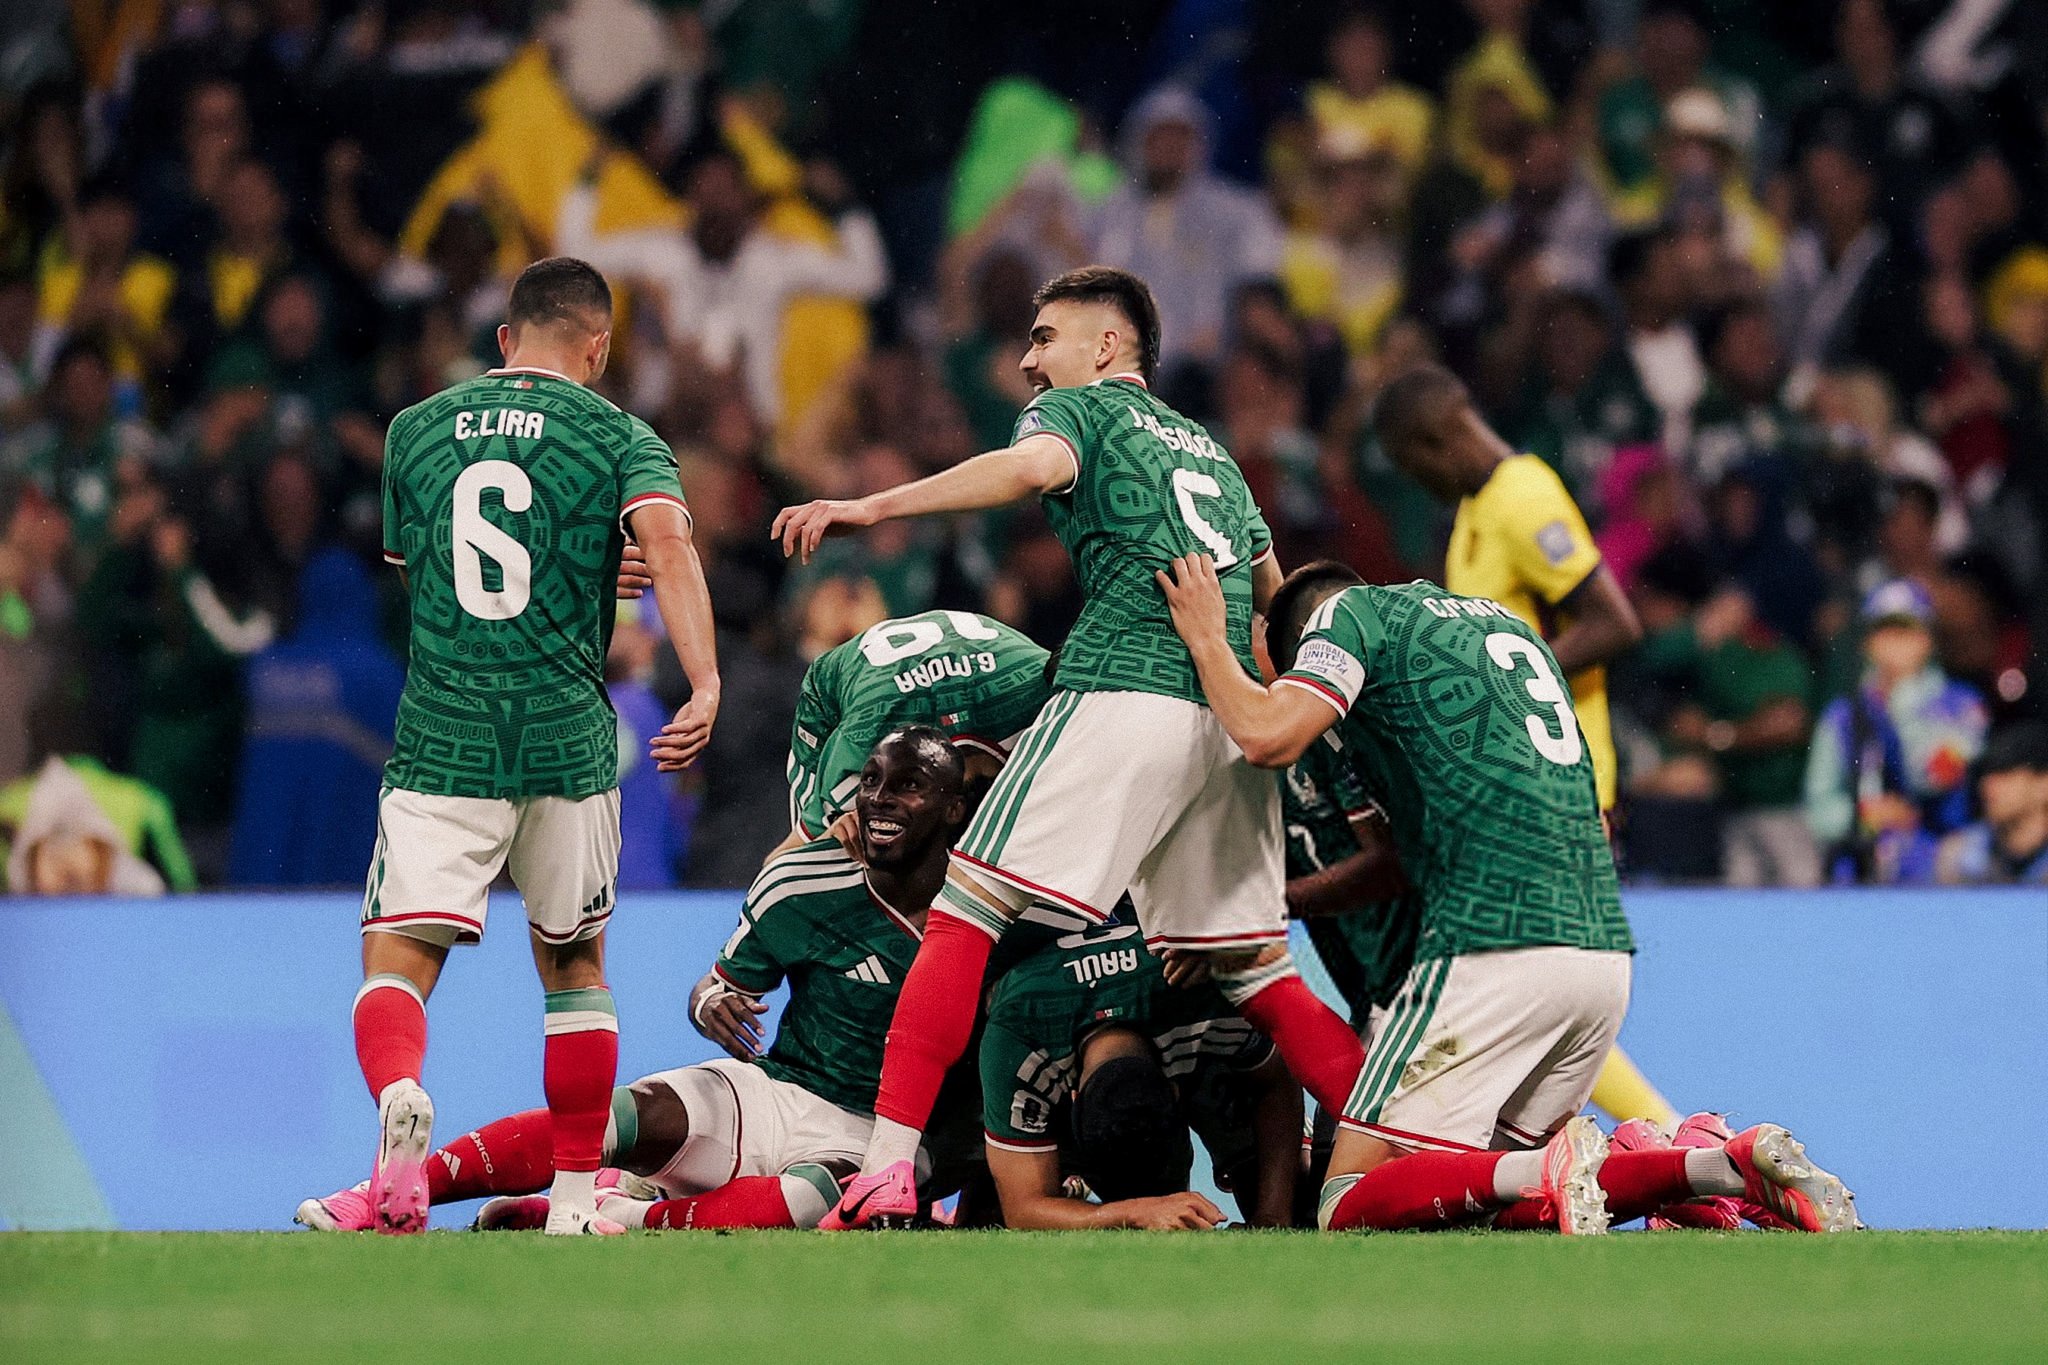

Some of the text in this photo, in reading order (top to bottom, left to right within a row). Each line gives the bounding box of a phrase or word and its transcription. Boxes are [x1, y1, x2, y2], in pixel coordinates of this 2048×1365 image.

[454, 409, 545, 440] E.LIRA
[452, 460, 532, 620] 6
[1173, 468, 1238, 570] 5
[893, 651, 996, 693] G.MORA
[1485, 632, 1581, 765] 3
[1063, 948, 1138, 988] RAÚL
